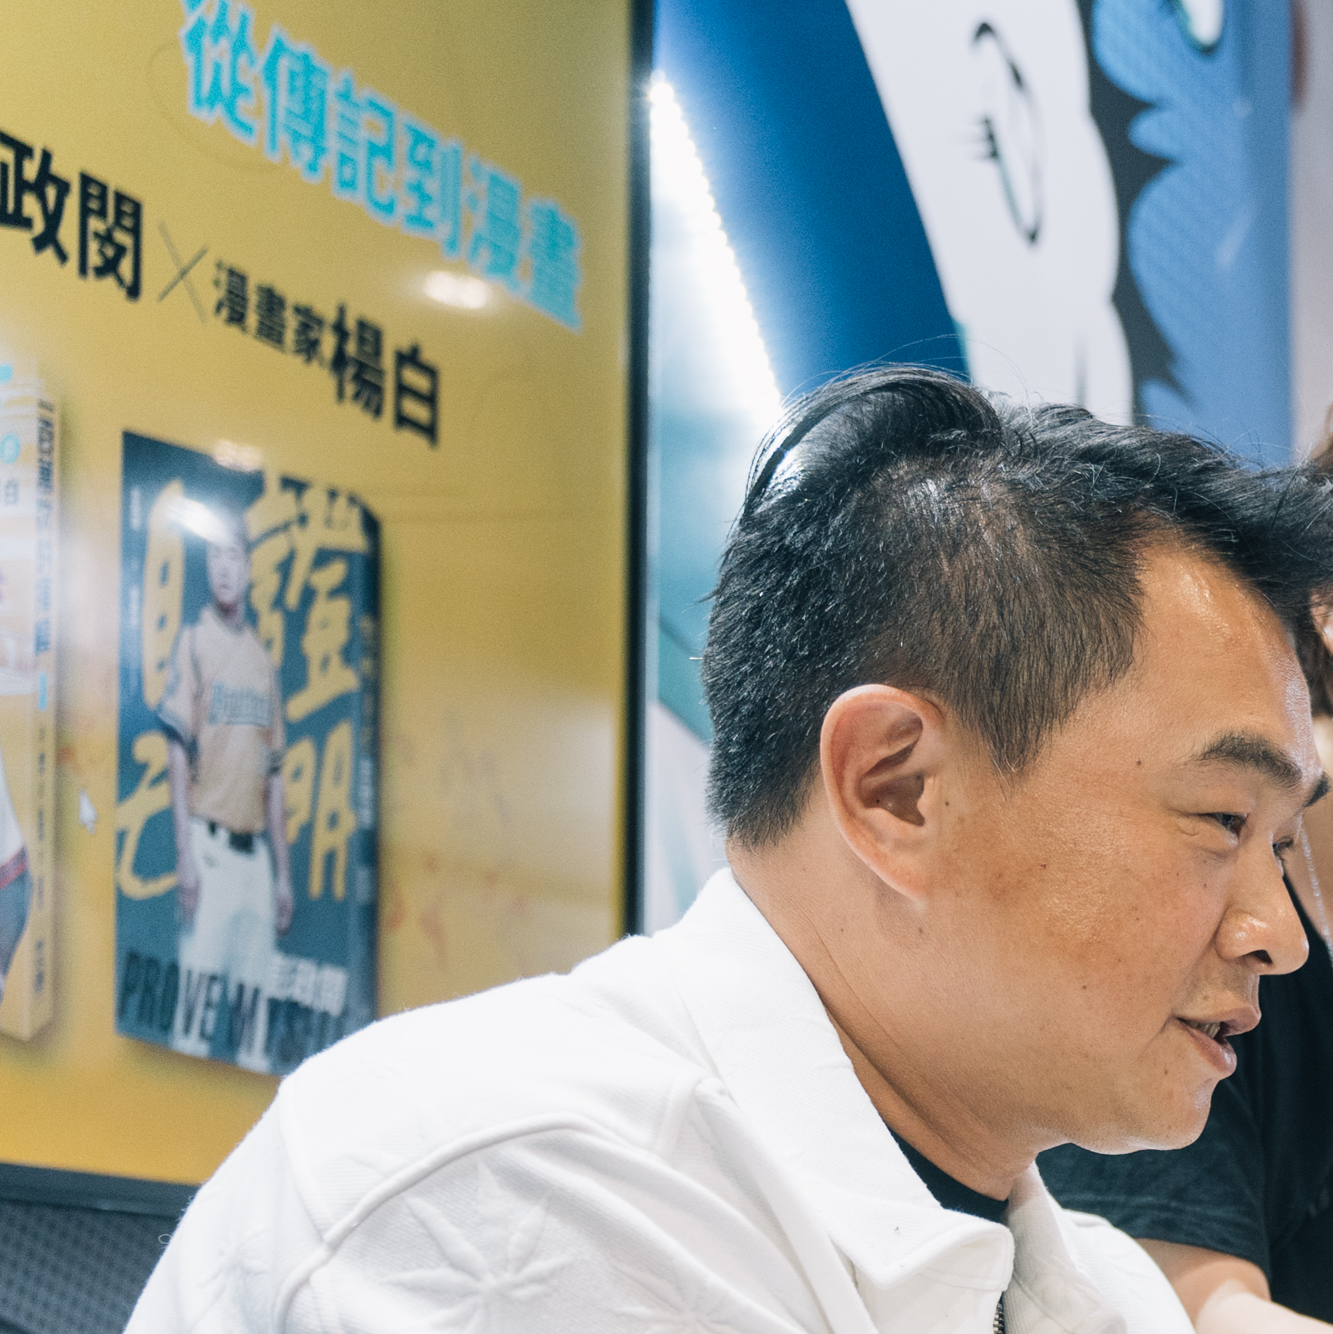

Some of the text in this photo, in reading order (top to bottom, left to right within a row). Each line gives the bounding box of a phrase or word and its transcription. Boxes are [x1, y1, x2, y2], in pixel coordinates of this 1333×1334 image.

[181, 0, 584, 333] 從傳記到漫畫
